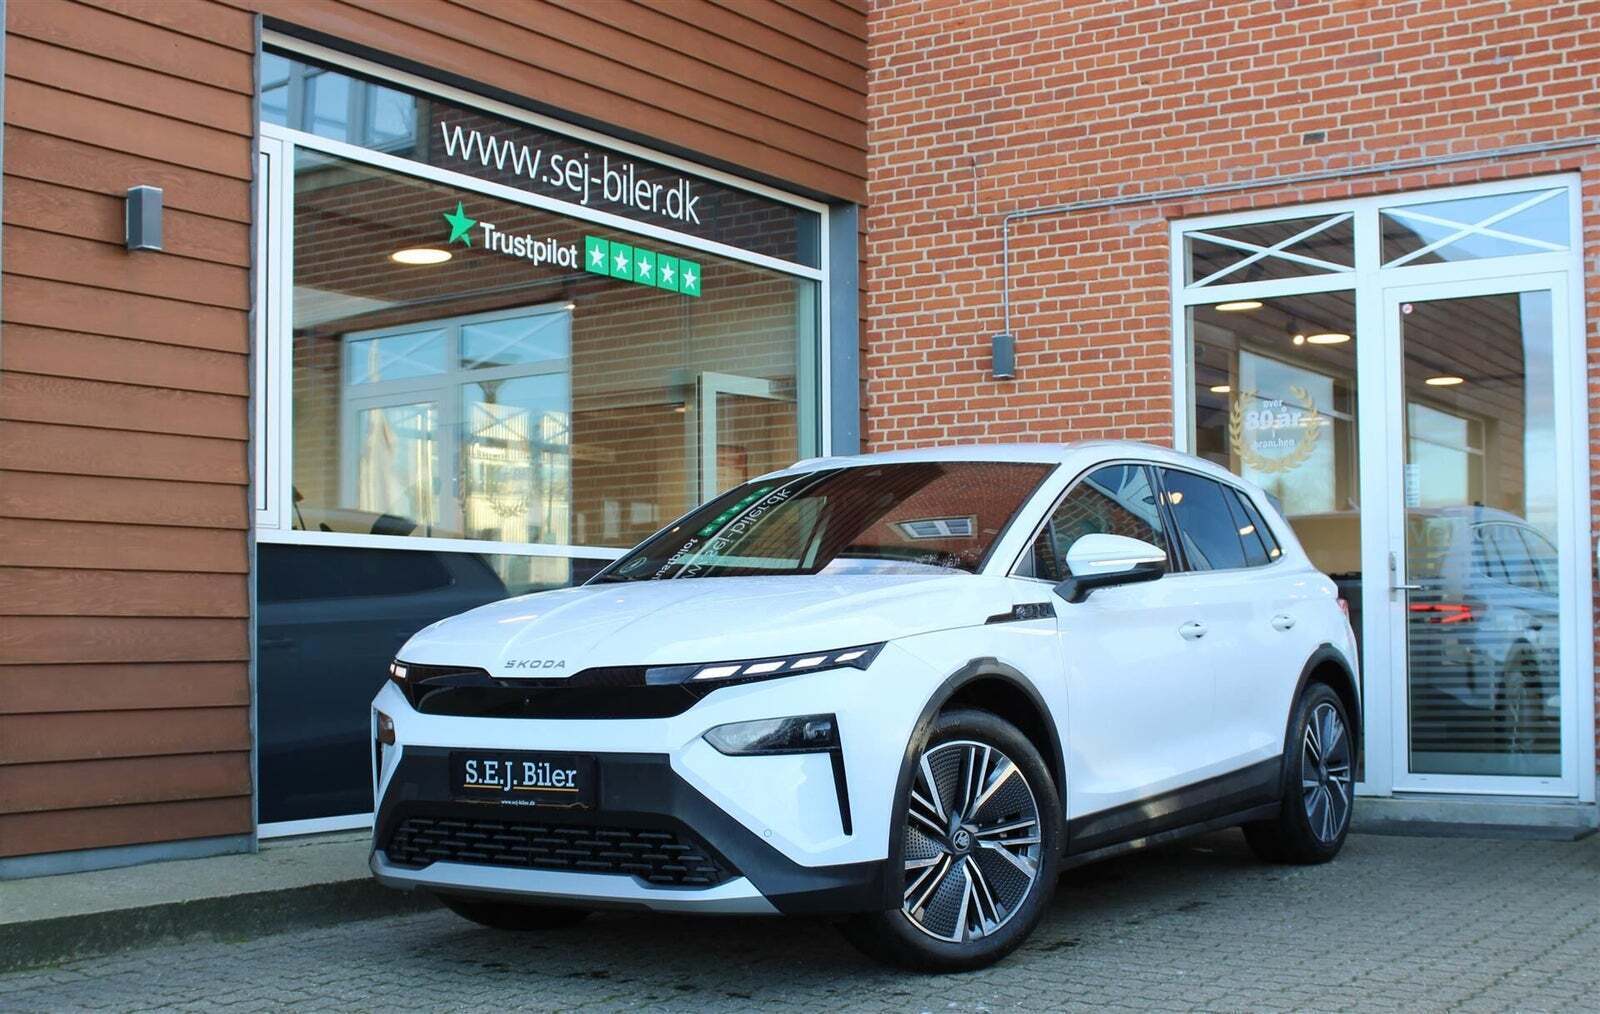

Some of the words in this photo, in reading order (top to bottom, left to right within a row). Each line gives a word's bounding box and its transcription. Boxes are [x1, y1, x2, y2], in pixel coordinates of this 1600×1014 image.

[441, 120, 700, 225] www.sej-biler.dk
[479, 221, 578, 269] Trustpilot
[1247, 409, 1274, 429] 80
[465, 759, 518, 792] S.E.J.
[522, 762, 577, 788] Biler
